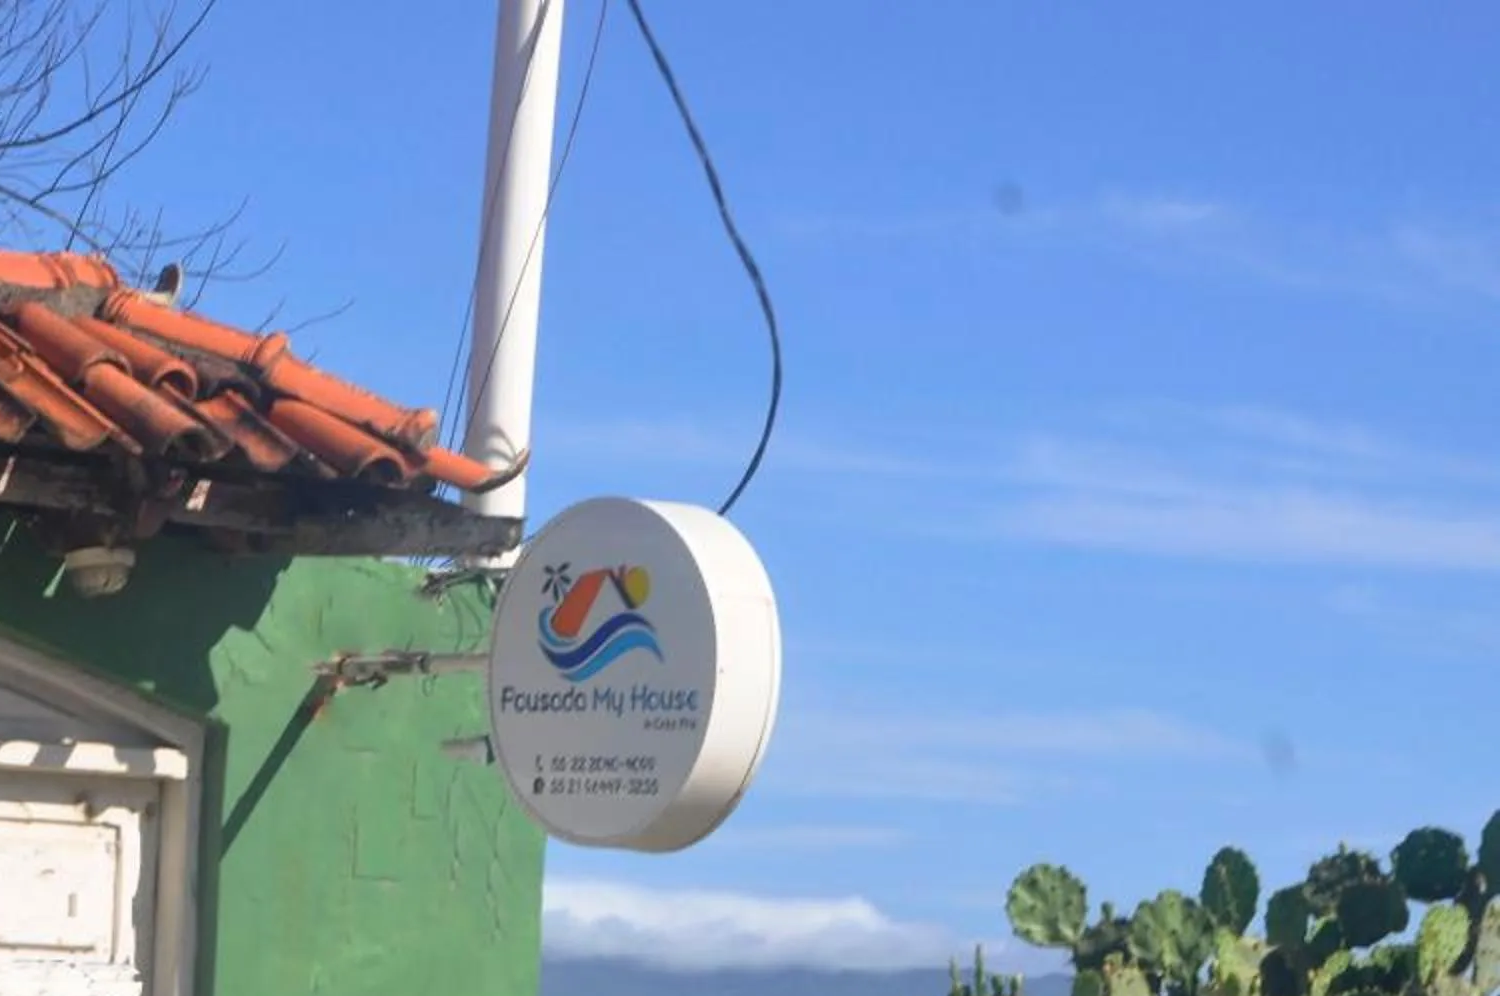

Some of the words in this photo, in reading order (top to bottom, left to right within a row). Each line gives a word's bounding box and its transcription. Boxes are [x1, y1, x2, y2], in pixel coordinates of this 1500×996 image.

[501, 685, 588, 713] Pousada
[592, 688, 624, 717] My
[631, 683, 698, 711] House
